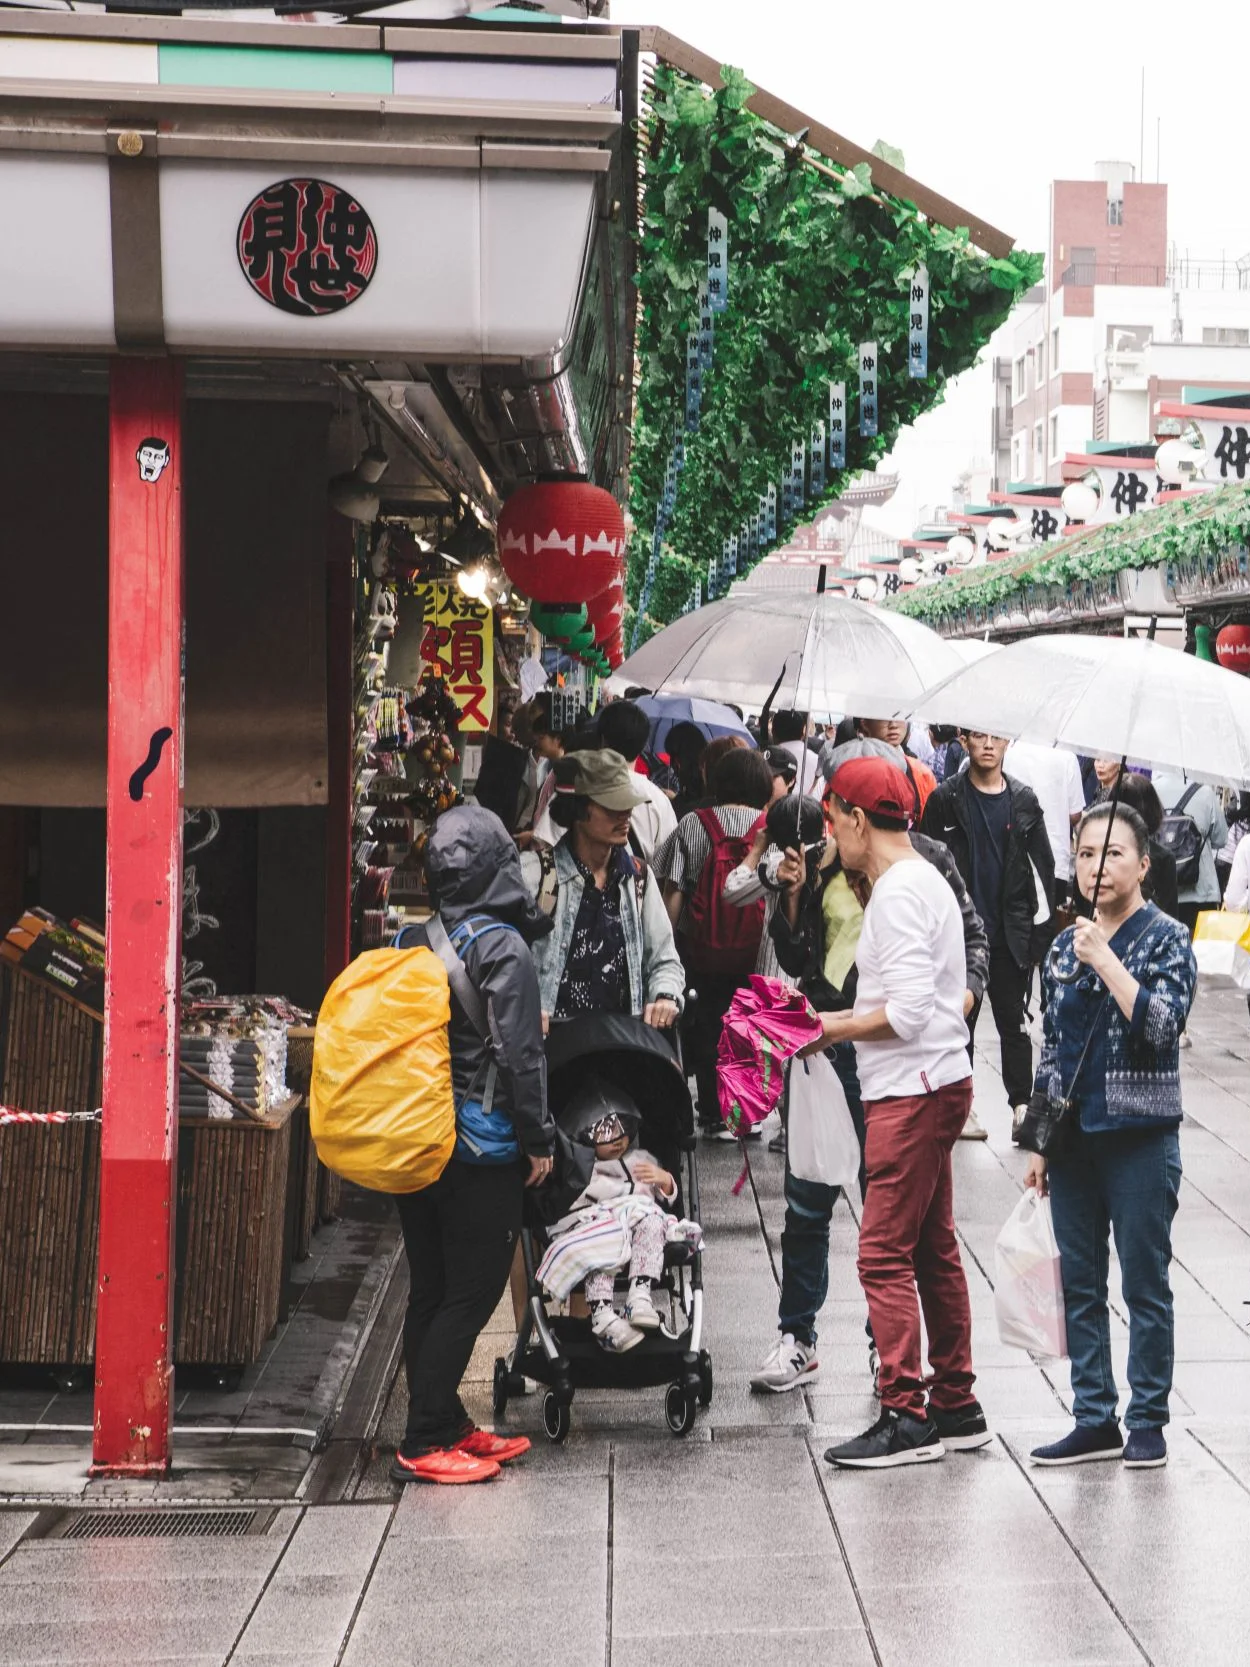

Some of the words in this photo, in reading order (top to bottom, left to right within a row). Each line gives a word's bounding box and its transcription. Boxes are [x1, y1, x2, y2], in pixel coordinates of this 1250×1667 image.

[709, 226, 721, 293] 仲見世
[911, 286, 924, 359] 仲見世
[862, 356, 875, 419] 仲見世
[832, 398, 843, 453] 仲見世
